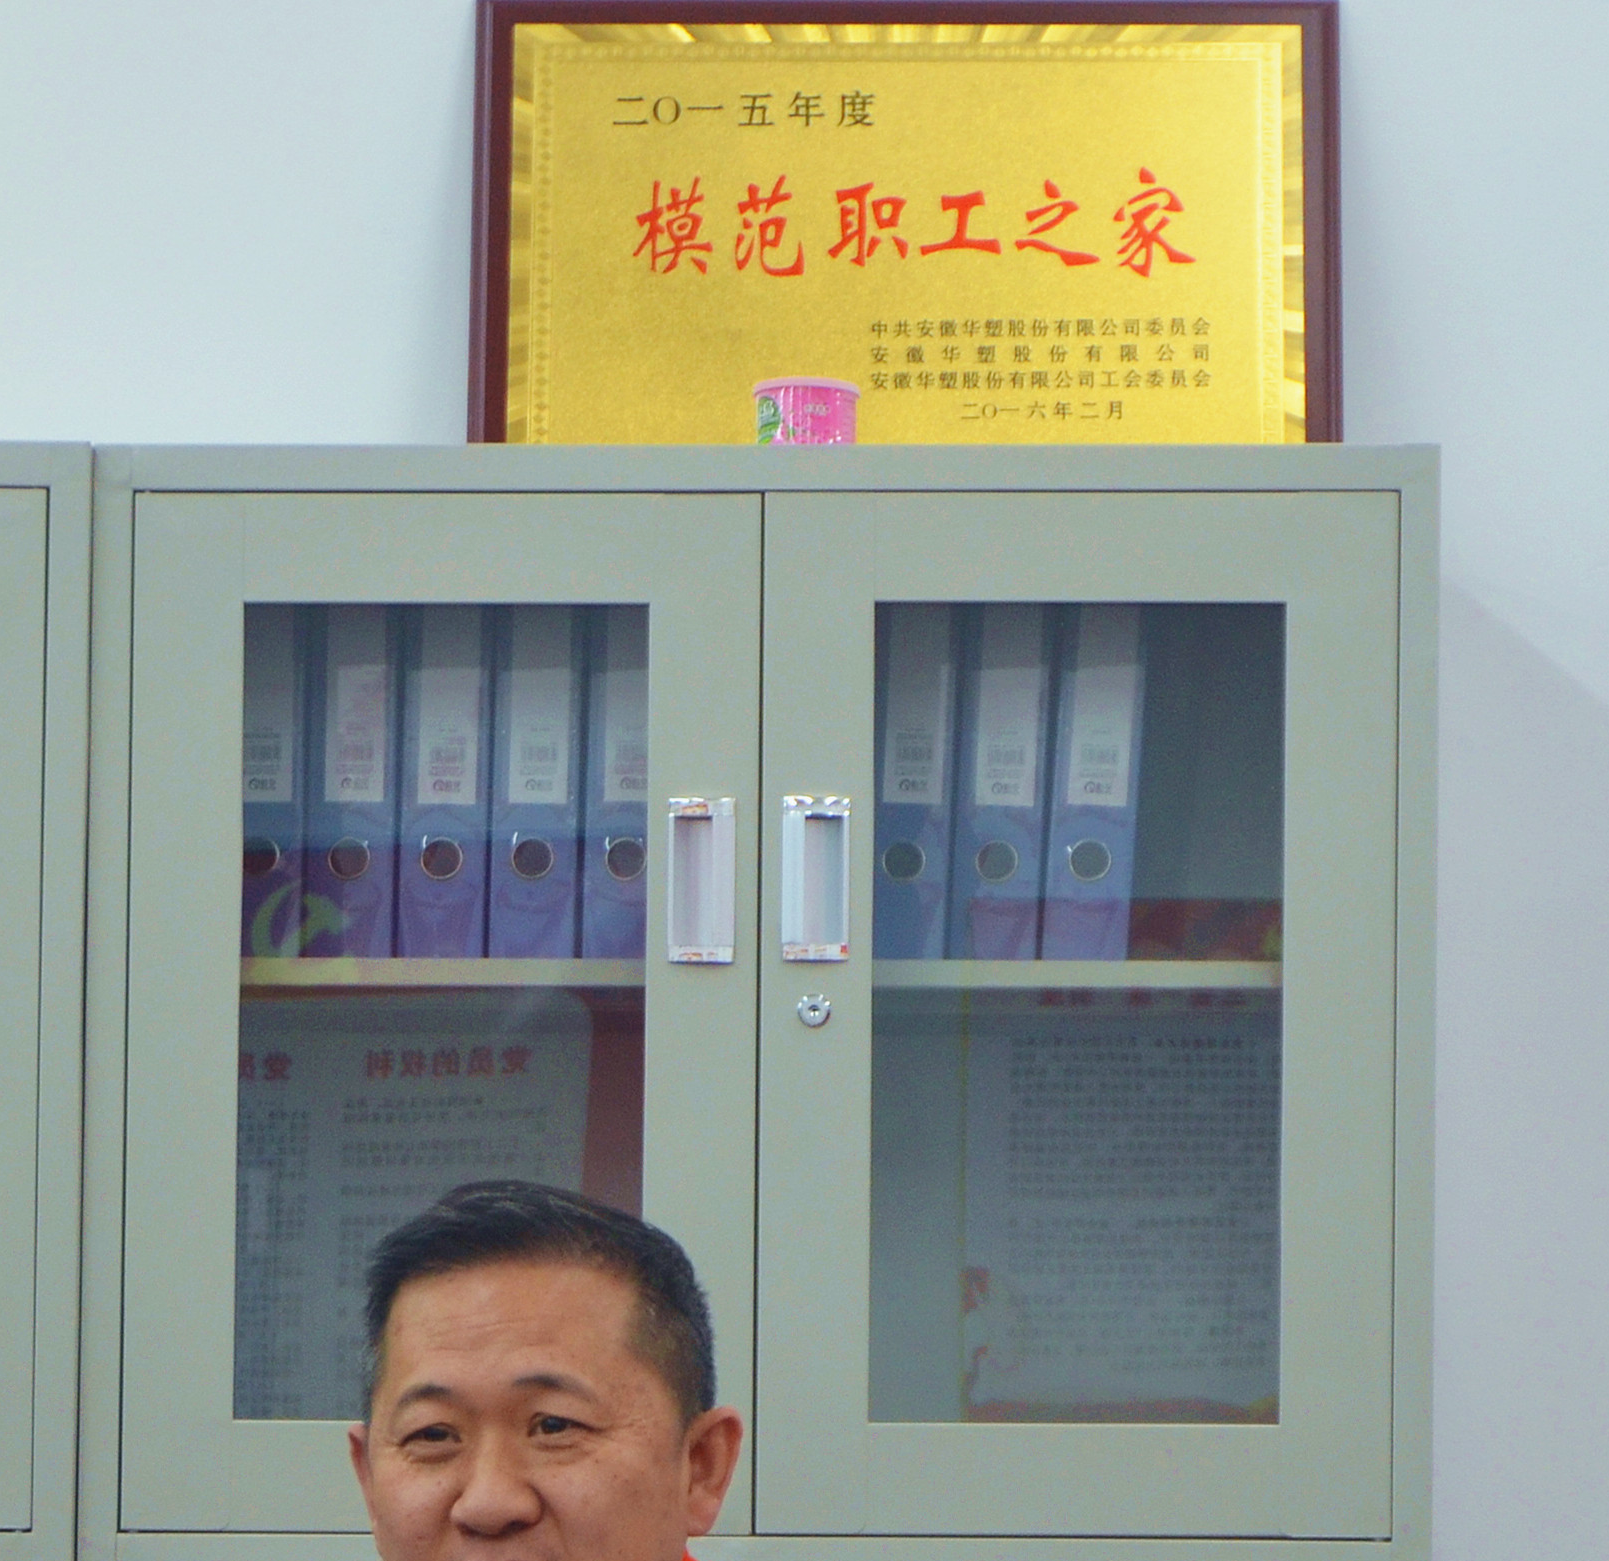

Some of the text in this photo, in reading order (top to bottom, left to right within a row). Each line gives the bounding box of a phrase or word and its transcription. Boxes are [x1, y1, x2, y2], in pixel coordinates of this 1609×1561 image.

[632, 168, 1197, 279] 模范职工之家
[871, 317, 1211, 339] 中共安徽华塑股份有限公司委员会
[871, 344, 1210, 364] 安徽华塑股份有限公司
[871, 369, 1211, 391] 安徽华塑股份有限公司工会委员会
